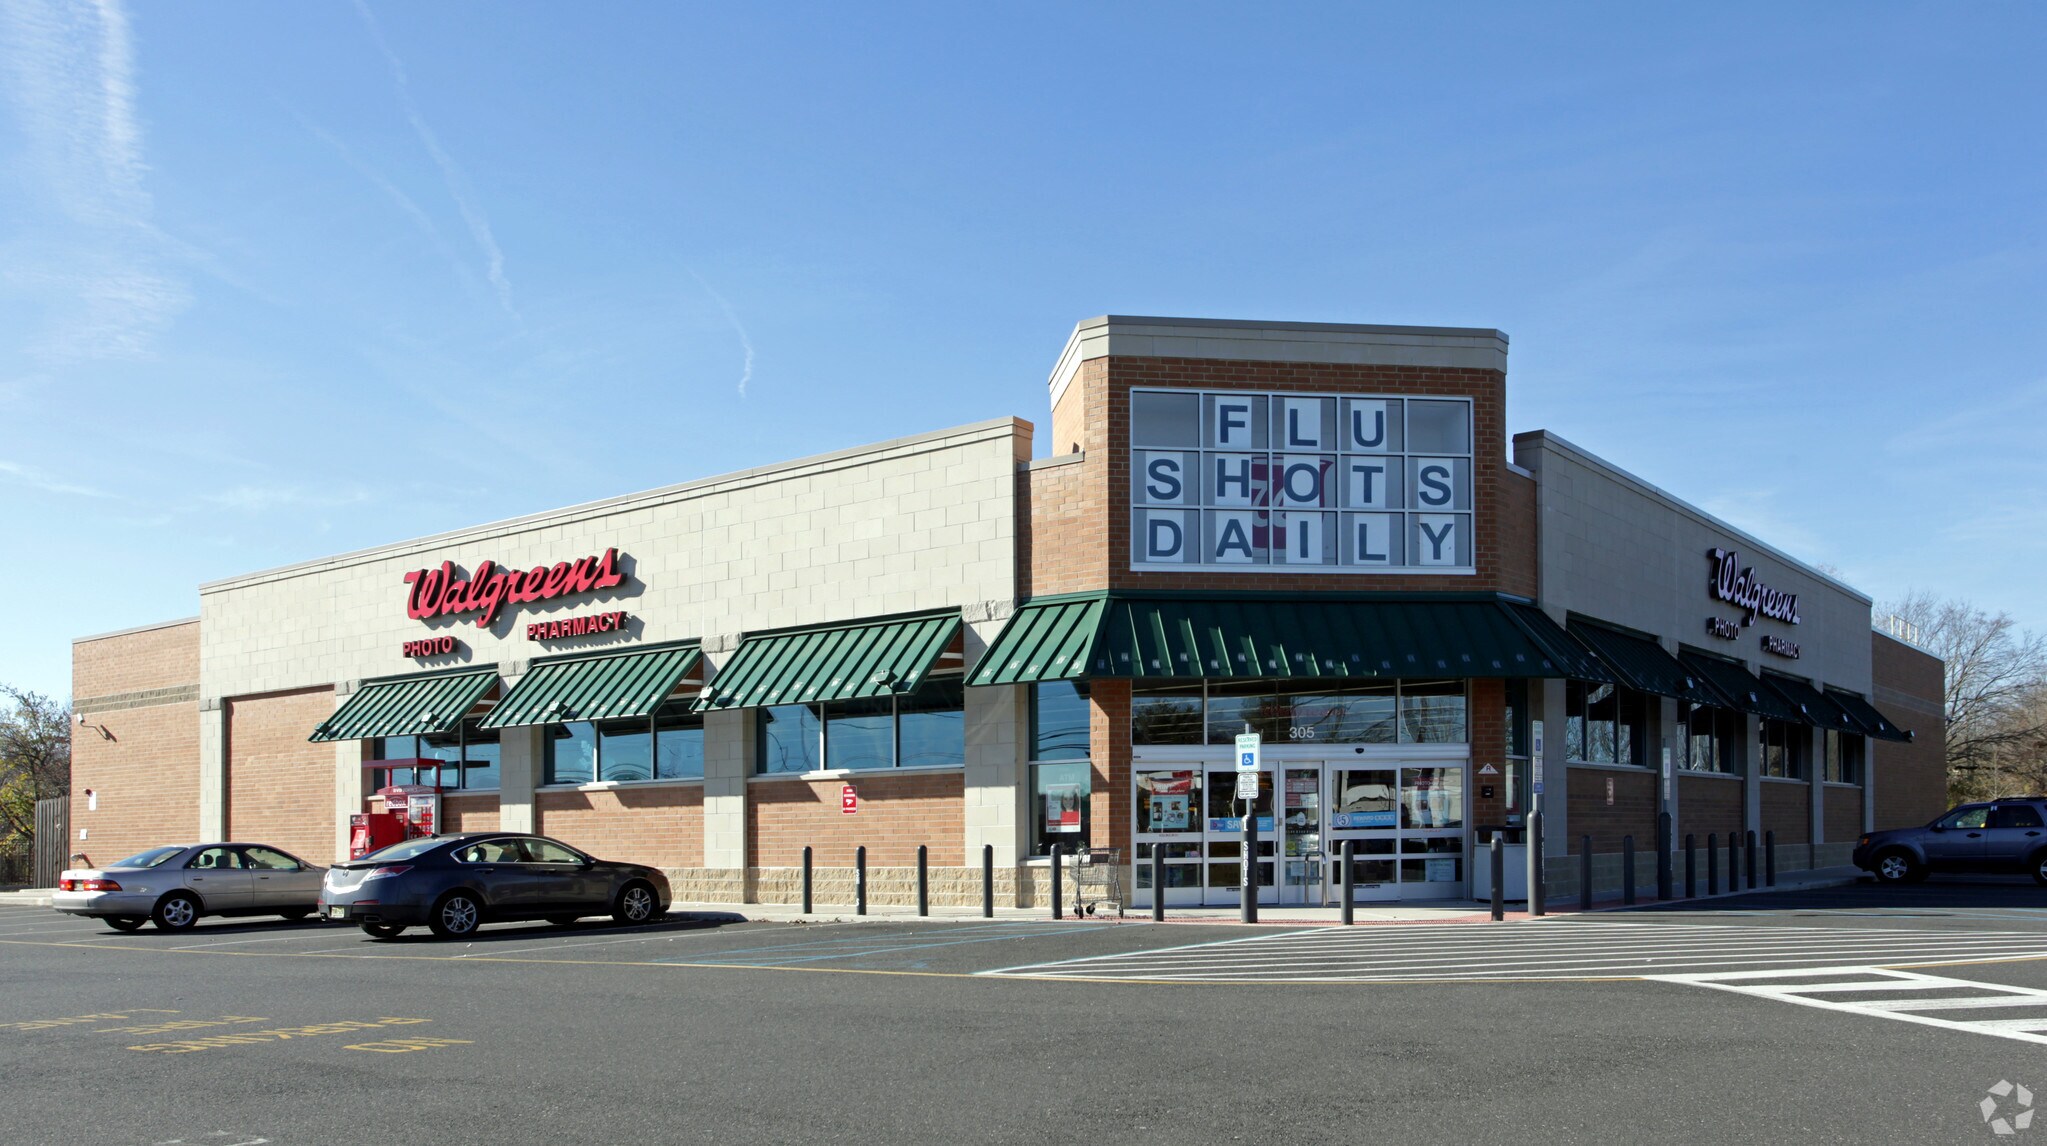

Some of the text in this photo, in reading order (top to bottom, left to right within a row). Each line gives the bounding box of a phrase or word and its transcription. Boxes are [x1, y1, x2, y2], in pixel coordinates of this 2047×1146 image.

[1219, 404, 1384, 447] FLU
[1147, 458, 1452, 506] SHOTS
[1148, 518, 1453, 562] DAILY
[403, 547, 626, 629] Walgreens
[1714, 547, 1801, 627] Walgreens
[403, 635, 455, 658] PHOTO
[527, 610, 625, 641] PHARMACY
[1713, 617, 1740, 641] PHOTO
[1289, 726, 1315, 739] 305
